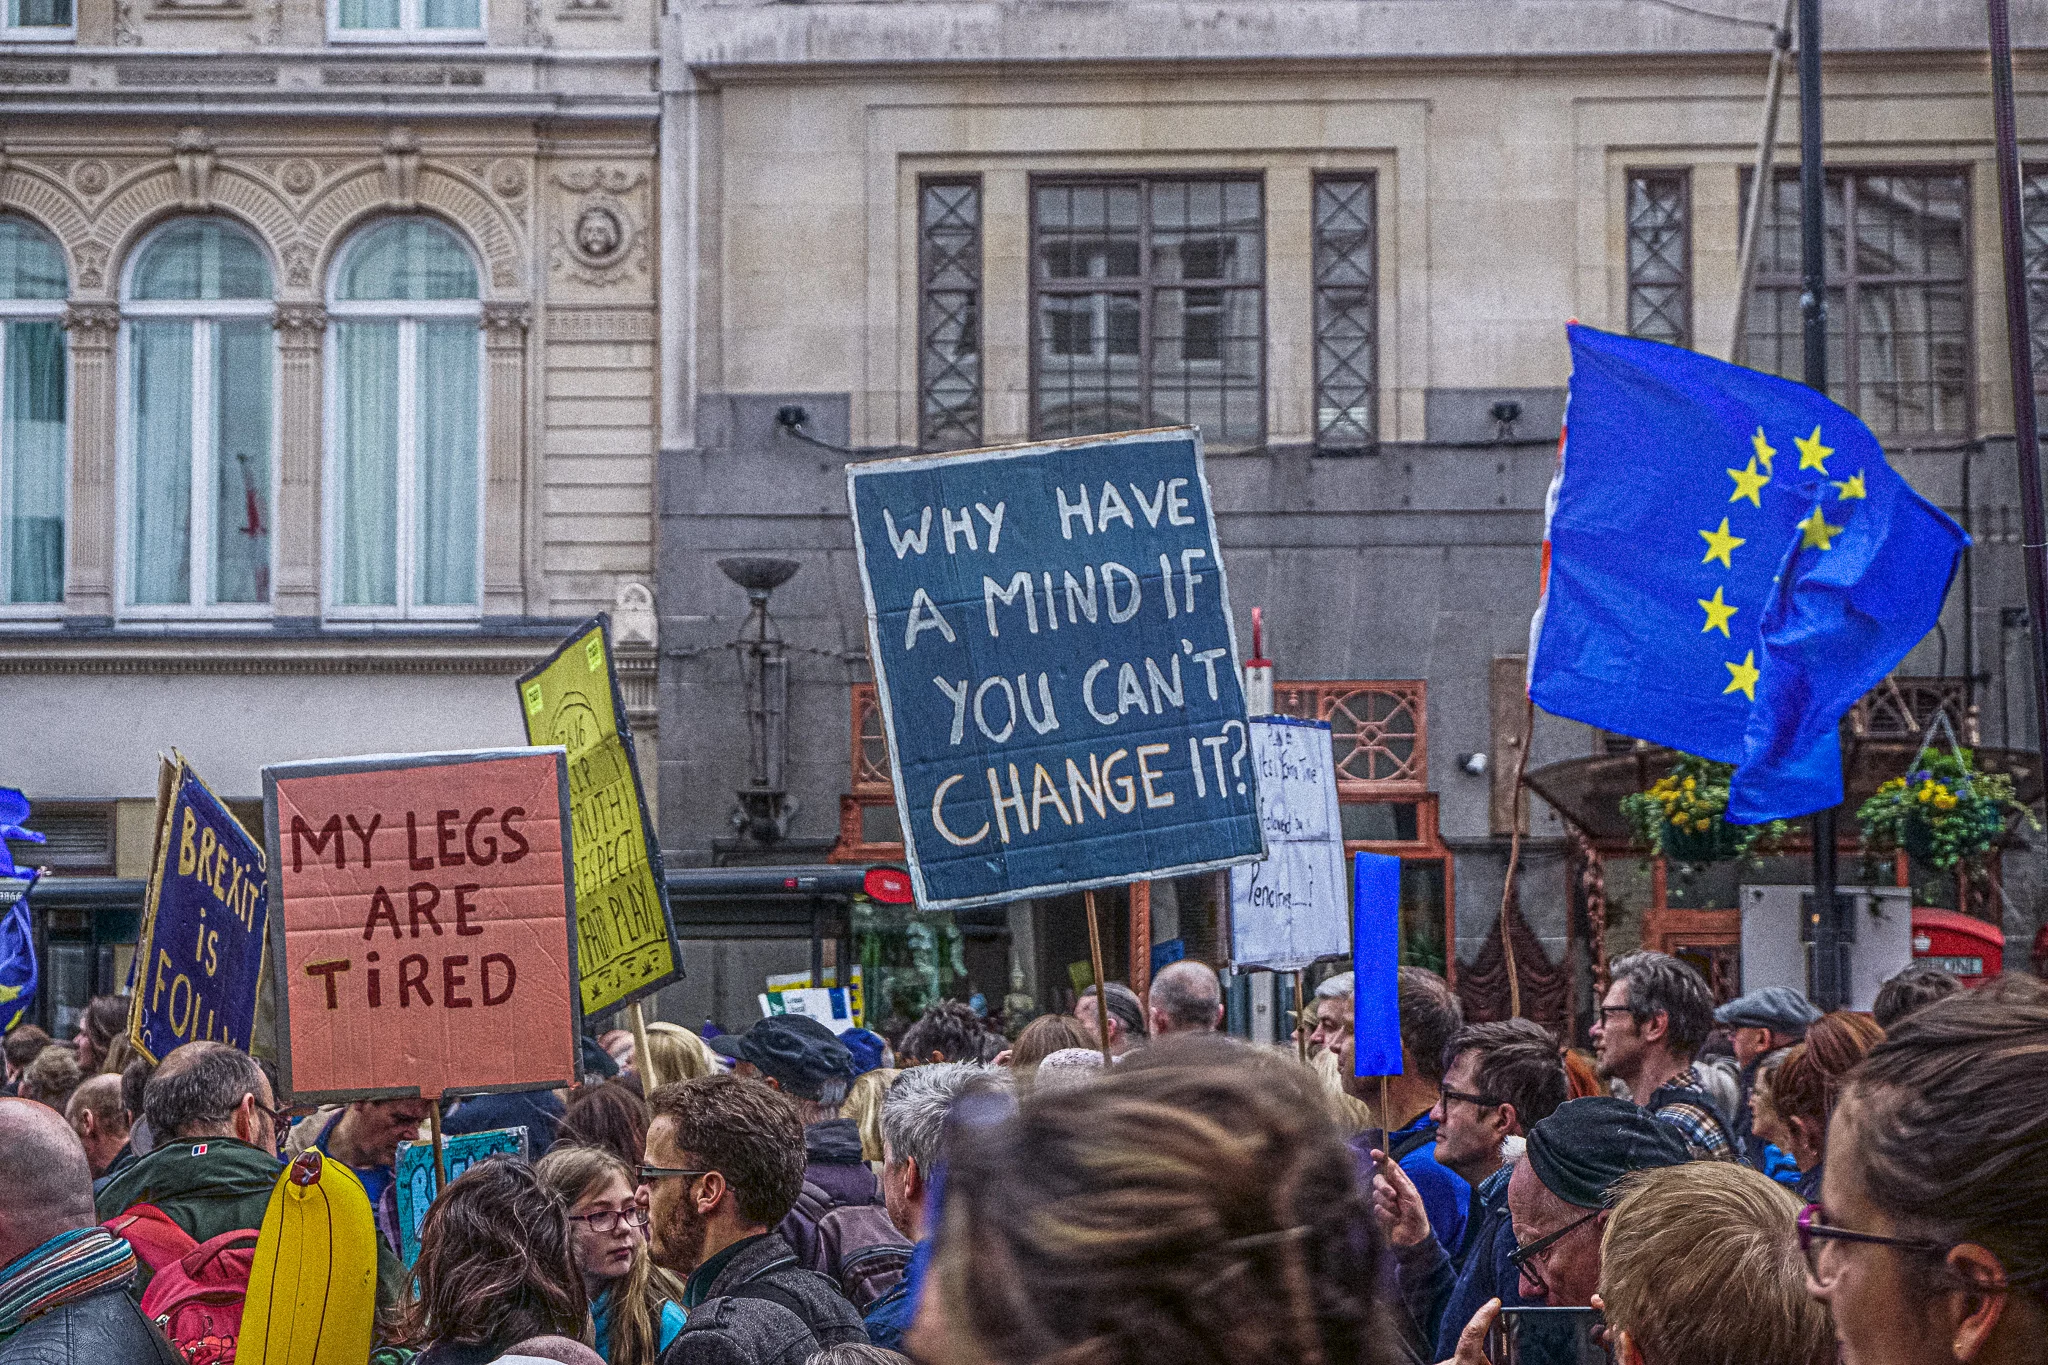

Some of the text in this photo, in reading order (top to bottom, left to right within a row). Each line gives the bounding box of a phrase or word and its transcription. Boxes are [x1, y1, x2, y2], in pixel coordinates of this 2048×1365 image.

[883, 478, 1196, 559] WHY HAVE
[905, 549, 1206, 650] A MIND IF
[933, 639, 1227, 745] YOU CAN'T
[931, 719, 1248, 847] CHANGE IT?
[290, 806, 530, 873] MY LEGS
[362, 881, 484, 941] ARE
[579, 878, 651, 968] FAIR PLAY
[304, 950, 517, 1010] TiRED
